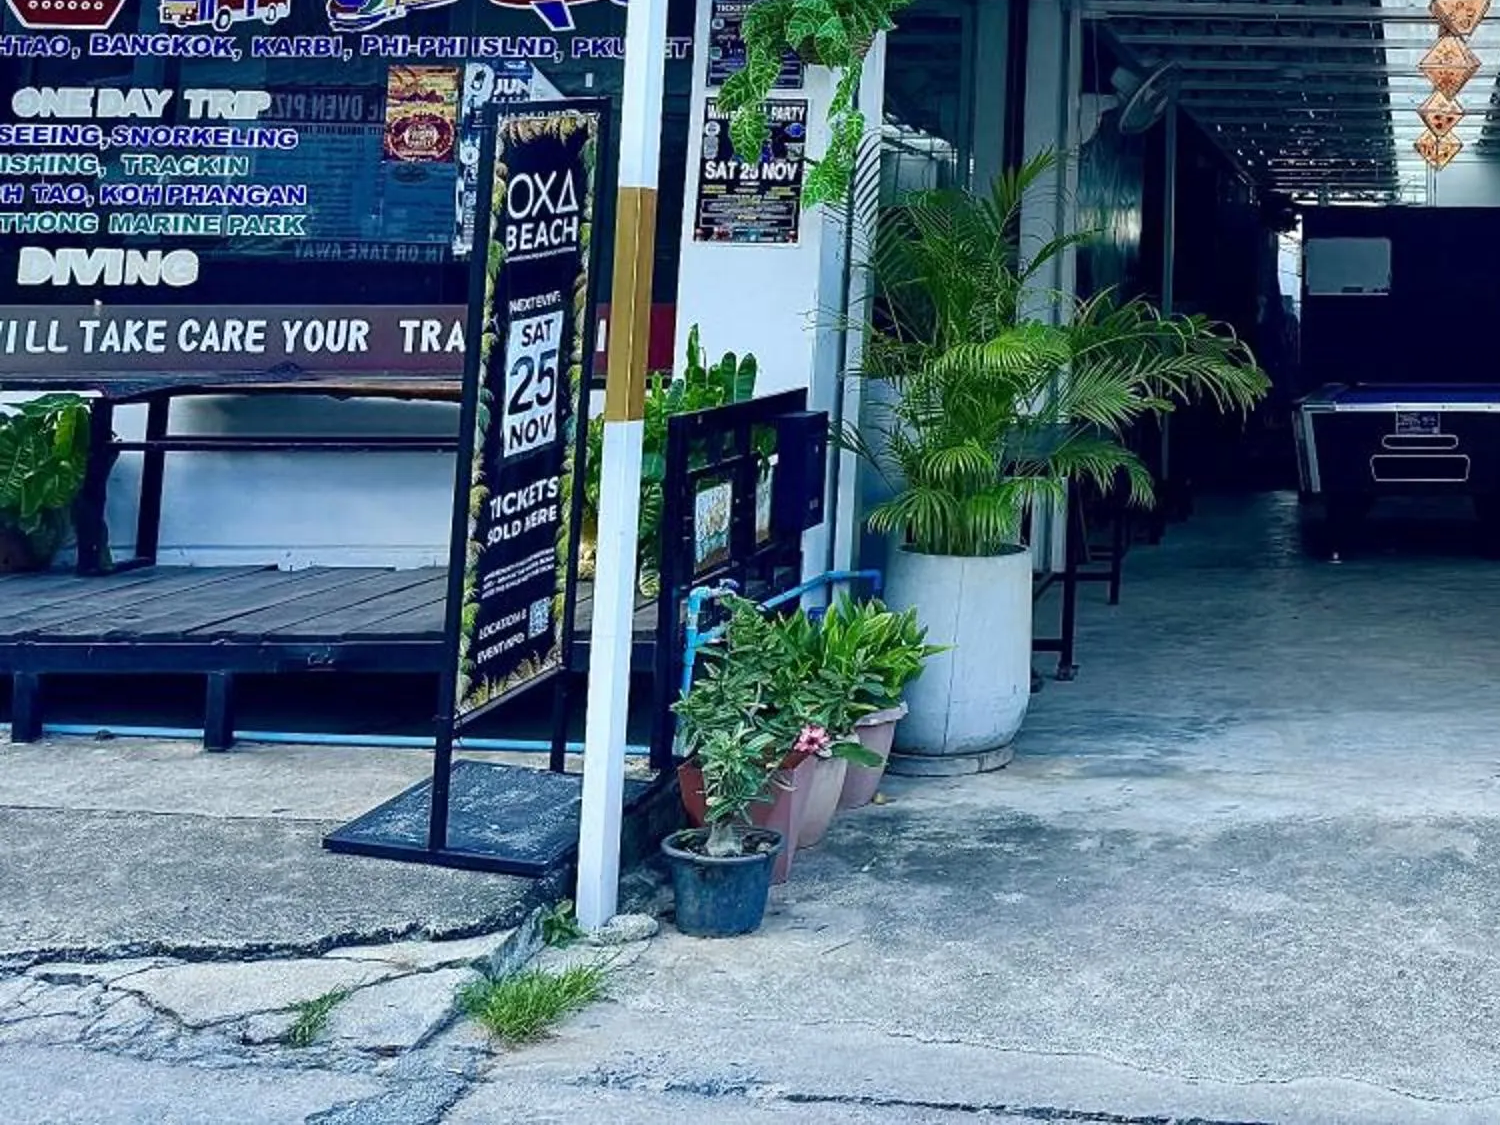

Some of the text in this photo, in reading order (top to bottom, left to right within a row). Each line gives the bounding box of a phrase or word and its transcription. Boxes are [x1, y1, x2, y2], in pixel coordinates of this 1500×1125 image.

[90, 34, 242, 61] BANGKOK,
[252, 36, 352, 62] KARBI,
[361, 35, 468, 58] PHI-PHI
[471, 36, 564, 63] ISLND,
[12, 87, 272, 119] ONE DAY TRIP
[111, 126, 299, 149] SNORKELING
[120, 154, 250, 176] TRACKIN
[705, 160, 738, 180] SAT
[762, 162, 797, 181] NOV
[31, 185, 95, 207] TAO,
[100, 184, 161, 205] KOH
[166, 184, 307, 206] PHANGAN
[108, 213, 221, 235] MARINE
[226, 214, 306, 236] PARK
[505, 215, 578, 252] BEACH
[17, 246, 200, 287] DIVING
[80, 320, 167, 353] TAKE
[178, 320, 266, 353] CARE
[282, 320, 369, 352] YOUR
[521, 318, 554, 347] SAT
[508, 349, 557, 416] 25
[509, 414, 552, 450] NOV
[490, 476, 559, 521] TICKETS
[487, 505, 557, 547] SOLD HERE
